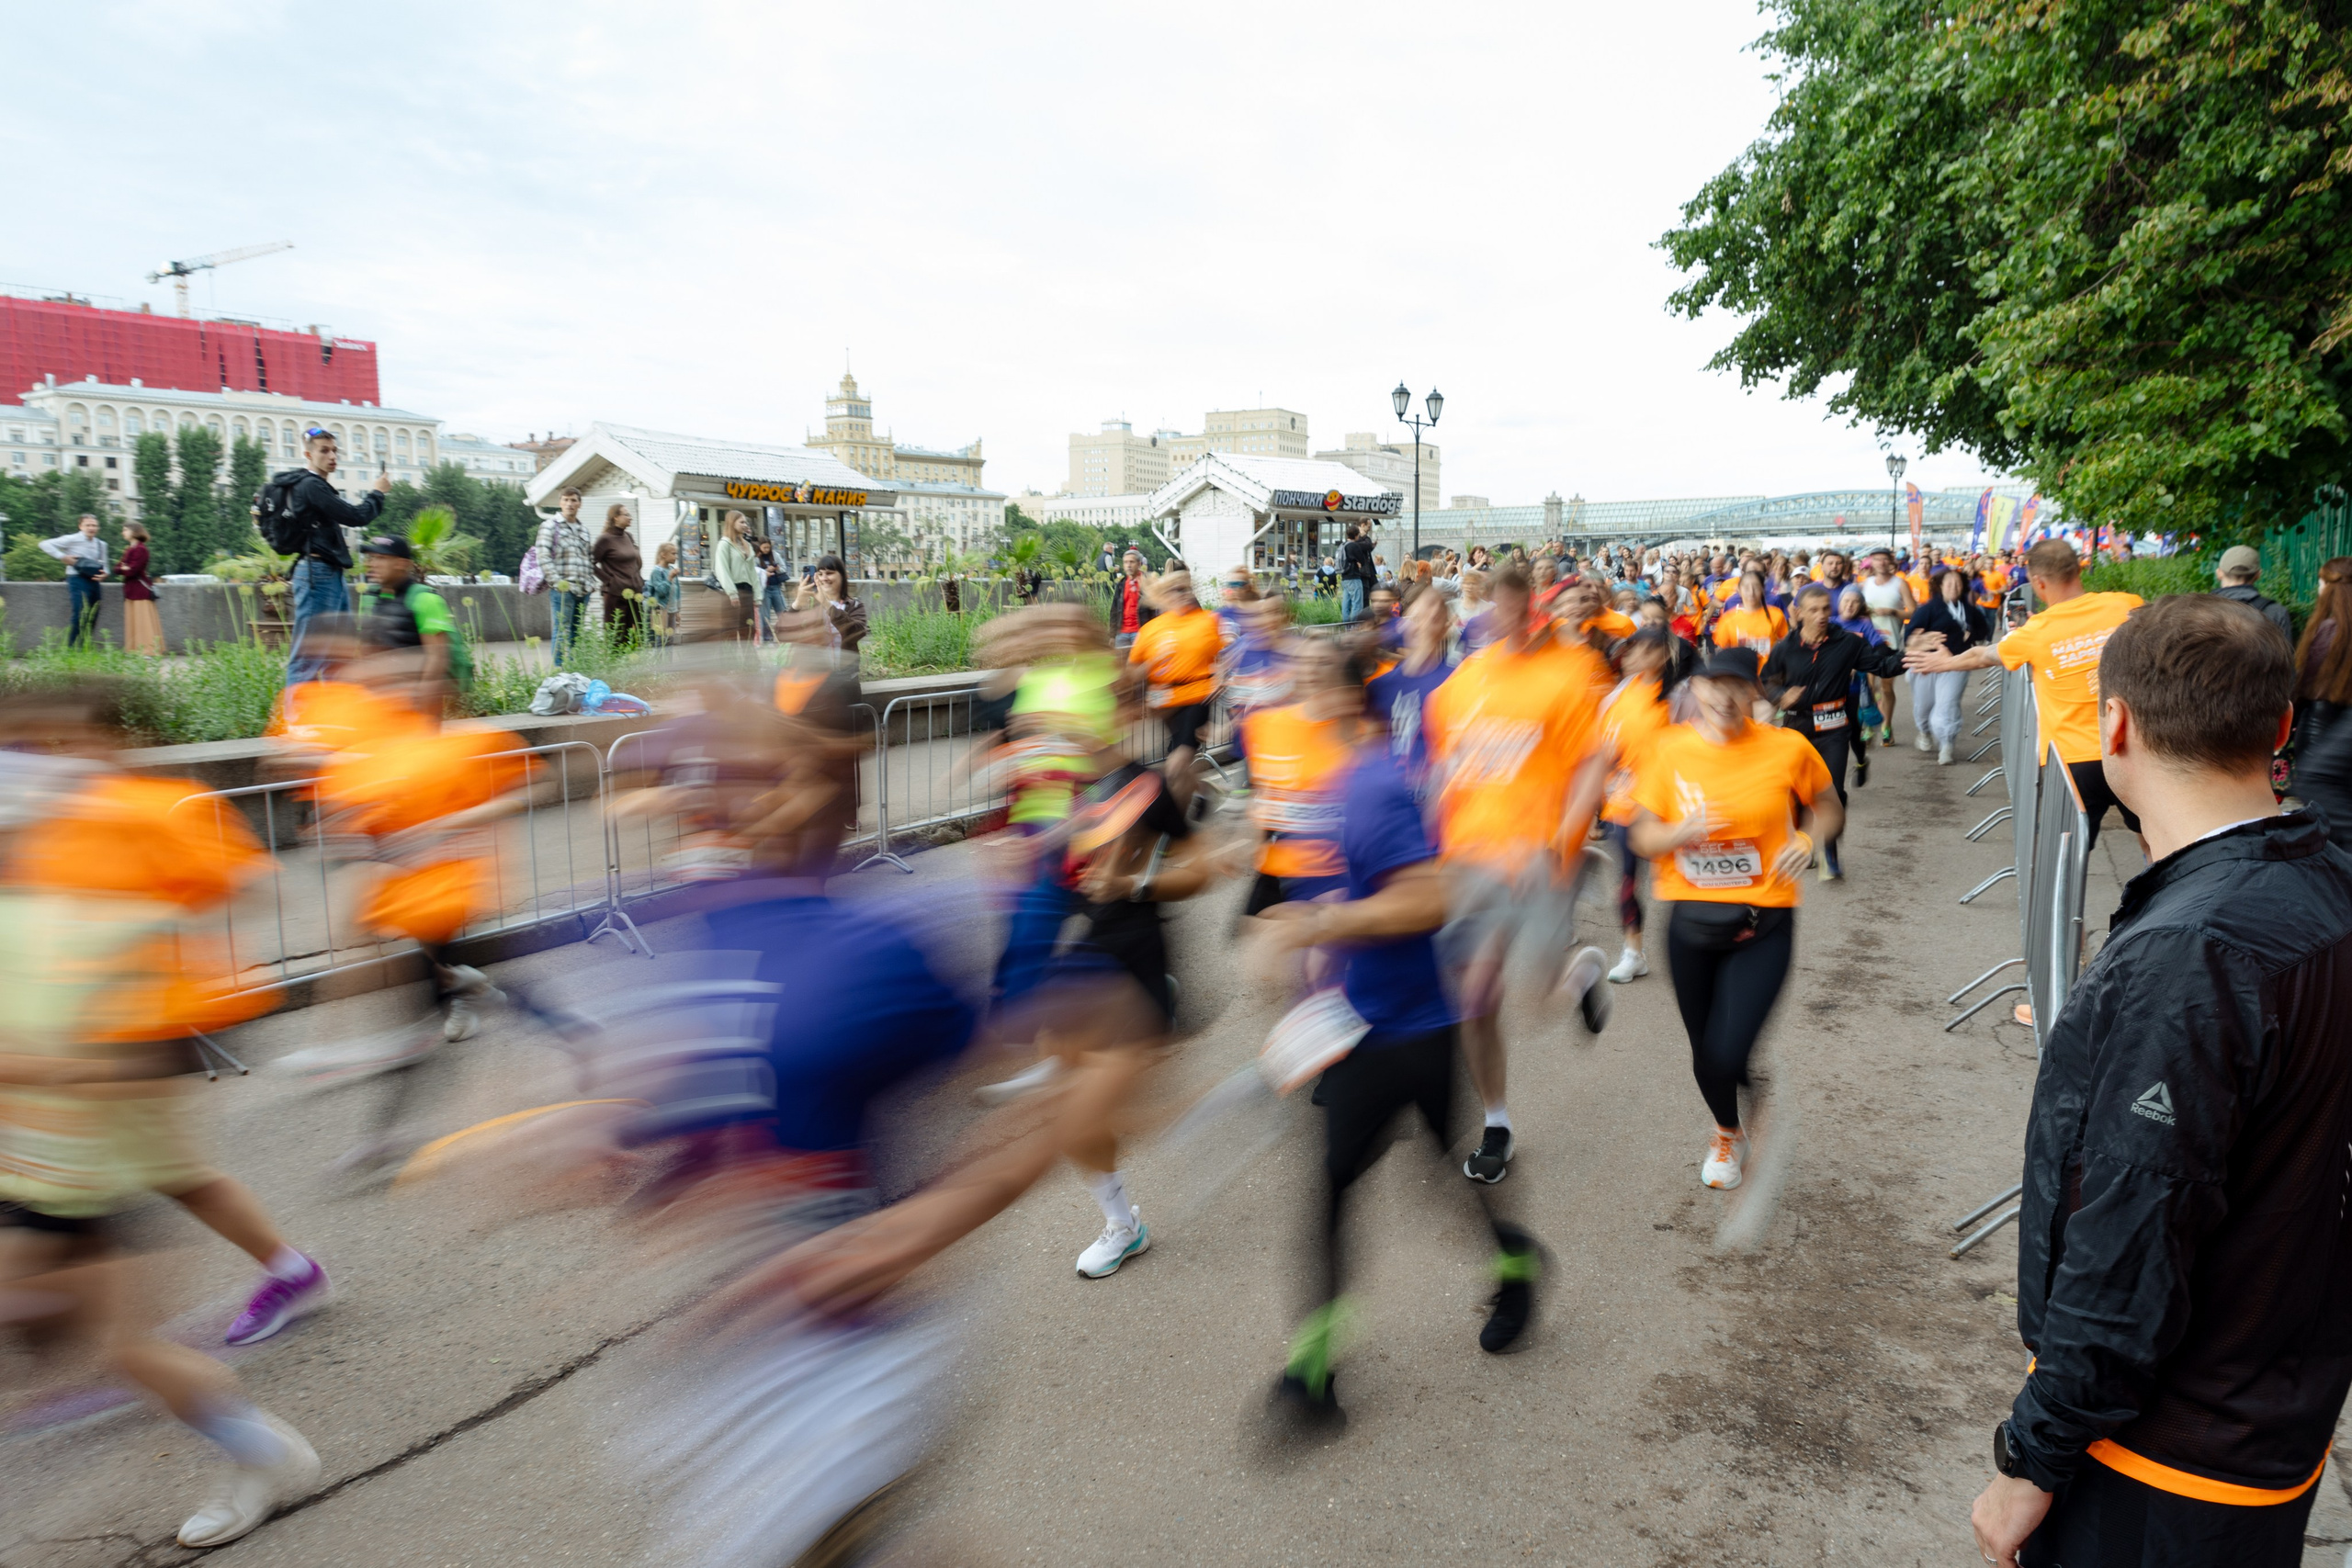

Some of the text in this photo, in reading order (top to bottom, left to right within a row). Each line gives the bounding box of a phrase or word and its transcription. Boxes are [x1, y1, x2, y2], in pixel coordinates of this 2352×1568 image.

[726, 482, 867, 505] ЧУРРОС МАНИЯ
[1342, 493, 1403, 514] Stardogs
[1700, 842, 1725, 854] БЕГ
[1691, 858, 1752, 875] 1496
[2131, 1102, 2177, 1125] Reebok
